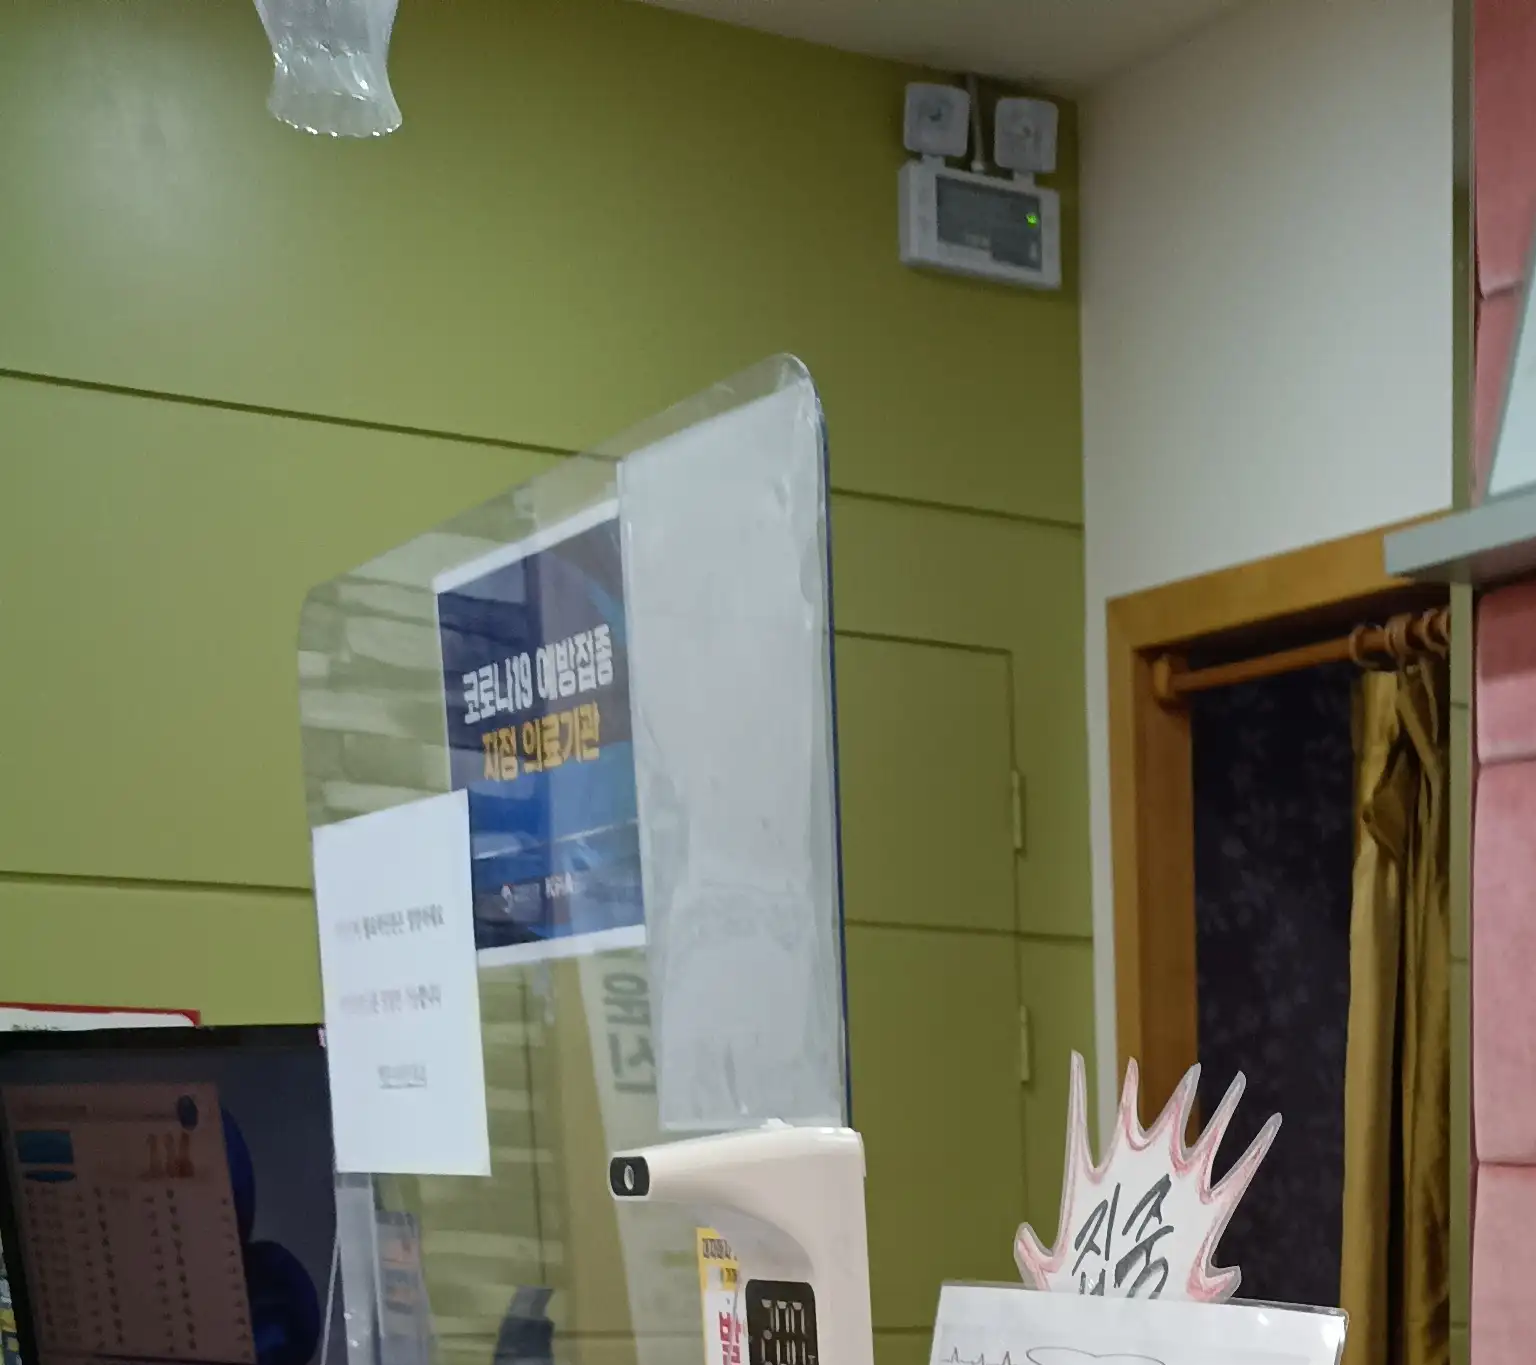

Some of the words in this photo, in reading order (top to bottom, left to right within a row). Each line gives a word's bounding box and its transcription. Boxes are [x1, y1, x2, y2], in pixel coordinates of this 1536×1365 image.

[462, 652, 532, 725] 코로나19
[535, 623, 614, 704] 예방접종
[480, 729, 518, 781] 지정
[521, 708, 603, 776] 의료기관
